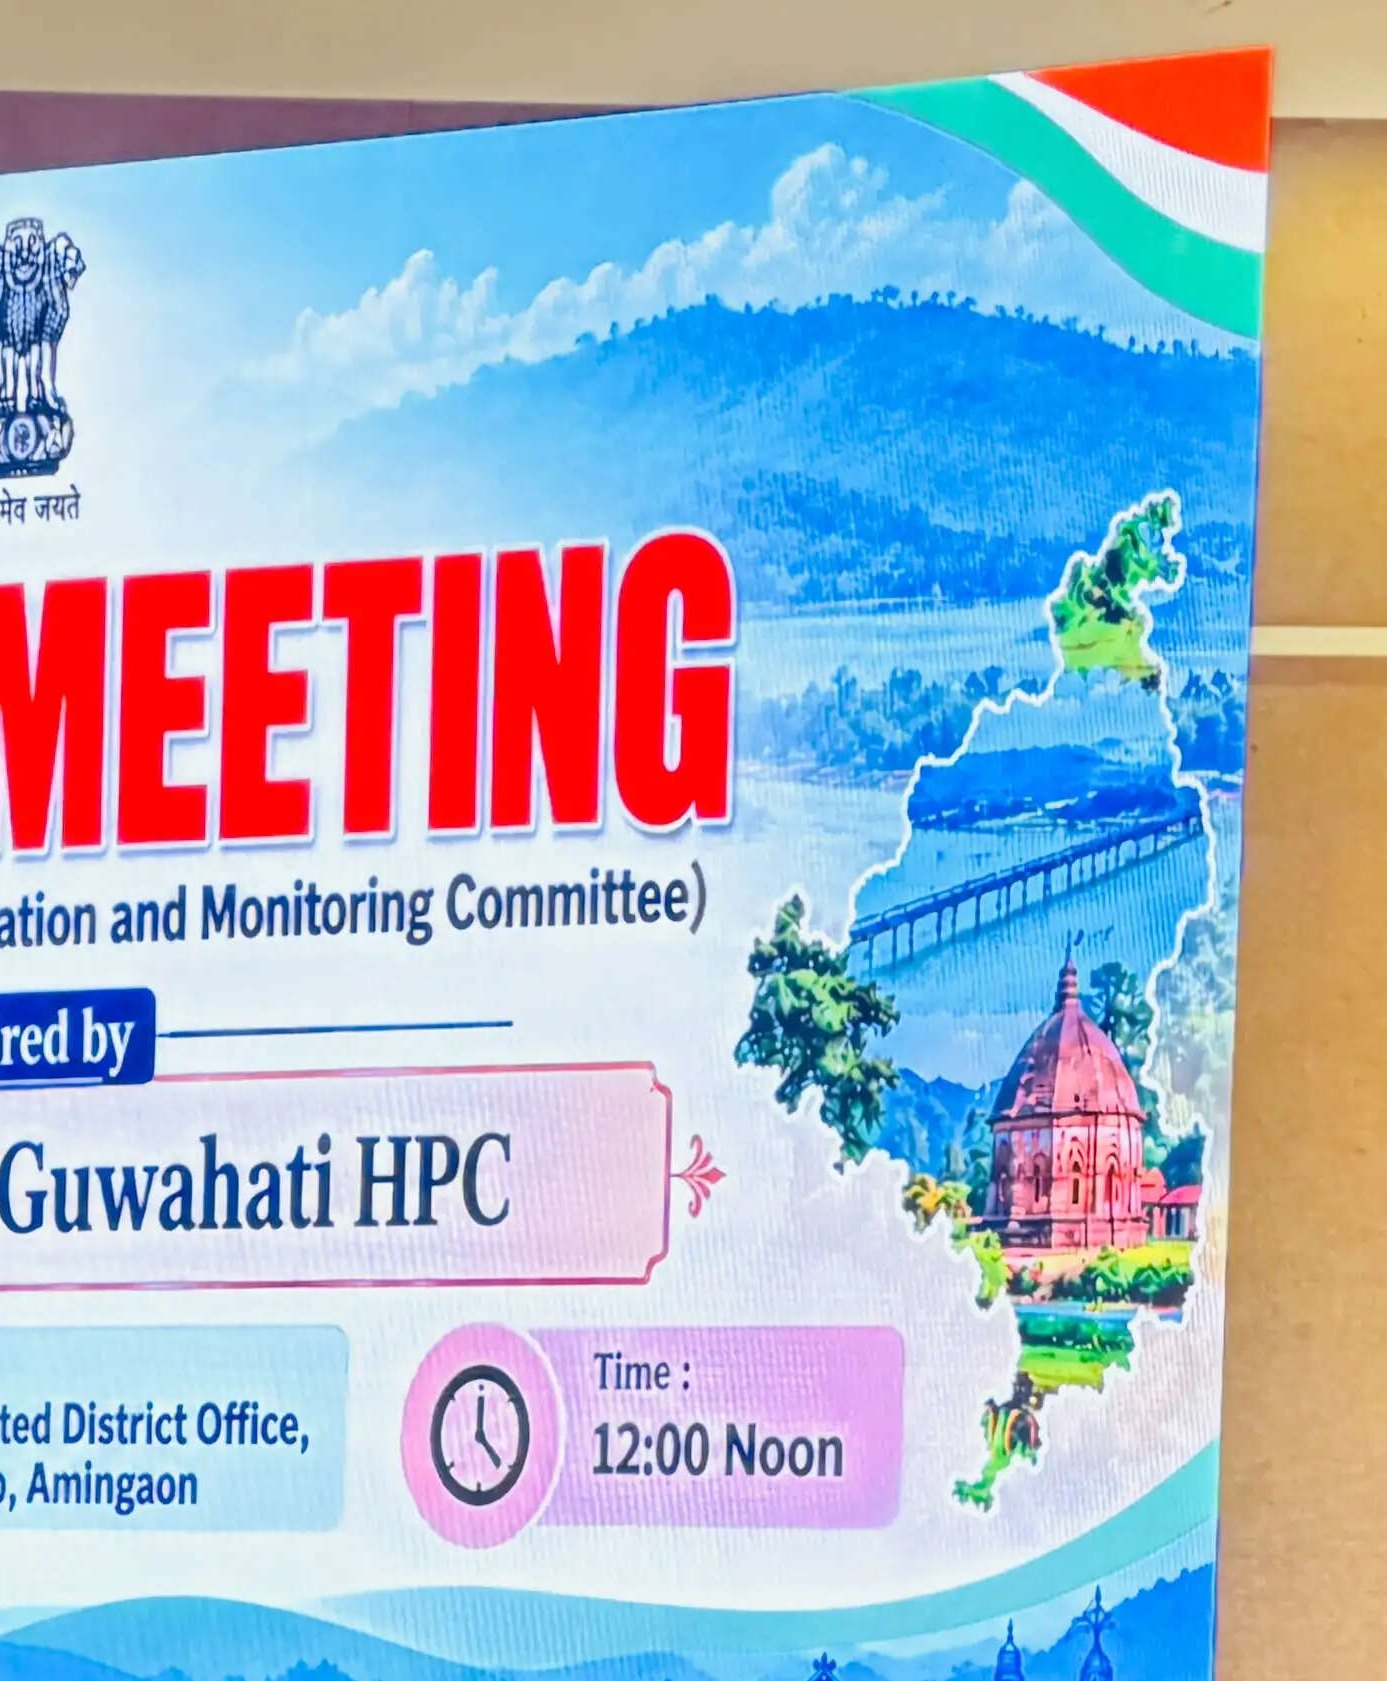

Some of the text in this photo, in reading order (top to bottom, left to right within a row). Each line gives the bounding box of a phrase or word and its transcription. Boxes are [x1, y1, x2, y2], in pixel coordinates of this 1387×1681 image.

[33, 484, 81, 521] जयते
[111, 885, 186, 943] and
[202, 877, 434, 945] Monitoring
[447, 862, 706, 933] Committee)
[82, 1008, 134, 1075] by
[355, 1133, 510, 1226] HPC
[594, 1352, 669, 1389] Time
[64, 1402, 187, 1445] District
[197, 1401, 308, 1454] Office,
[594, 1423, 842, 1476] 12:00 Noon
[27, 1461, 197, 1515] Amingaon
